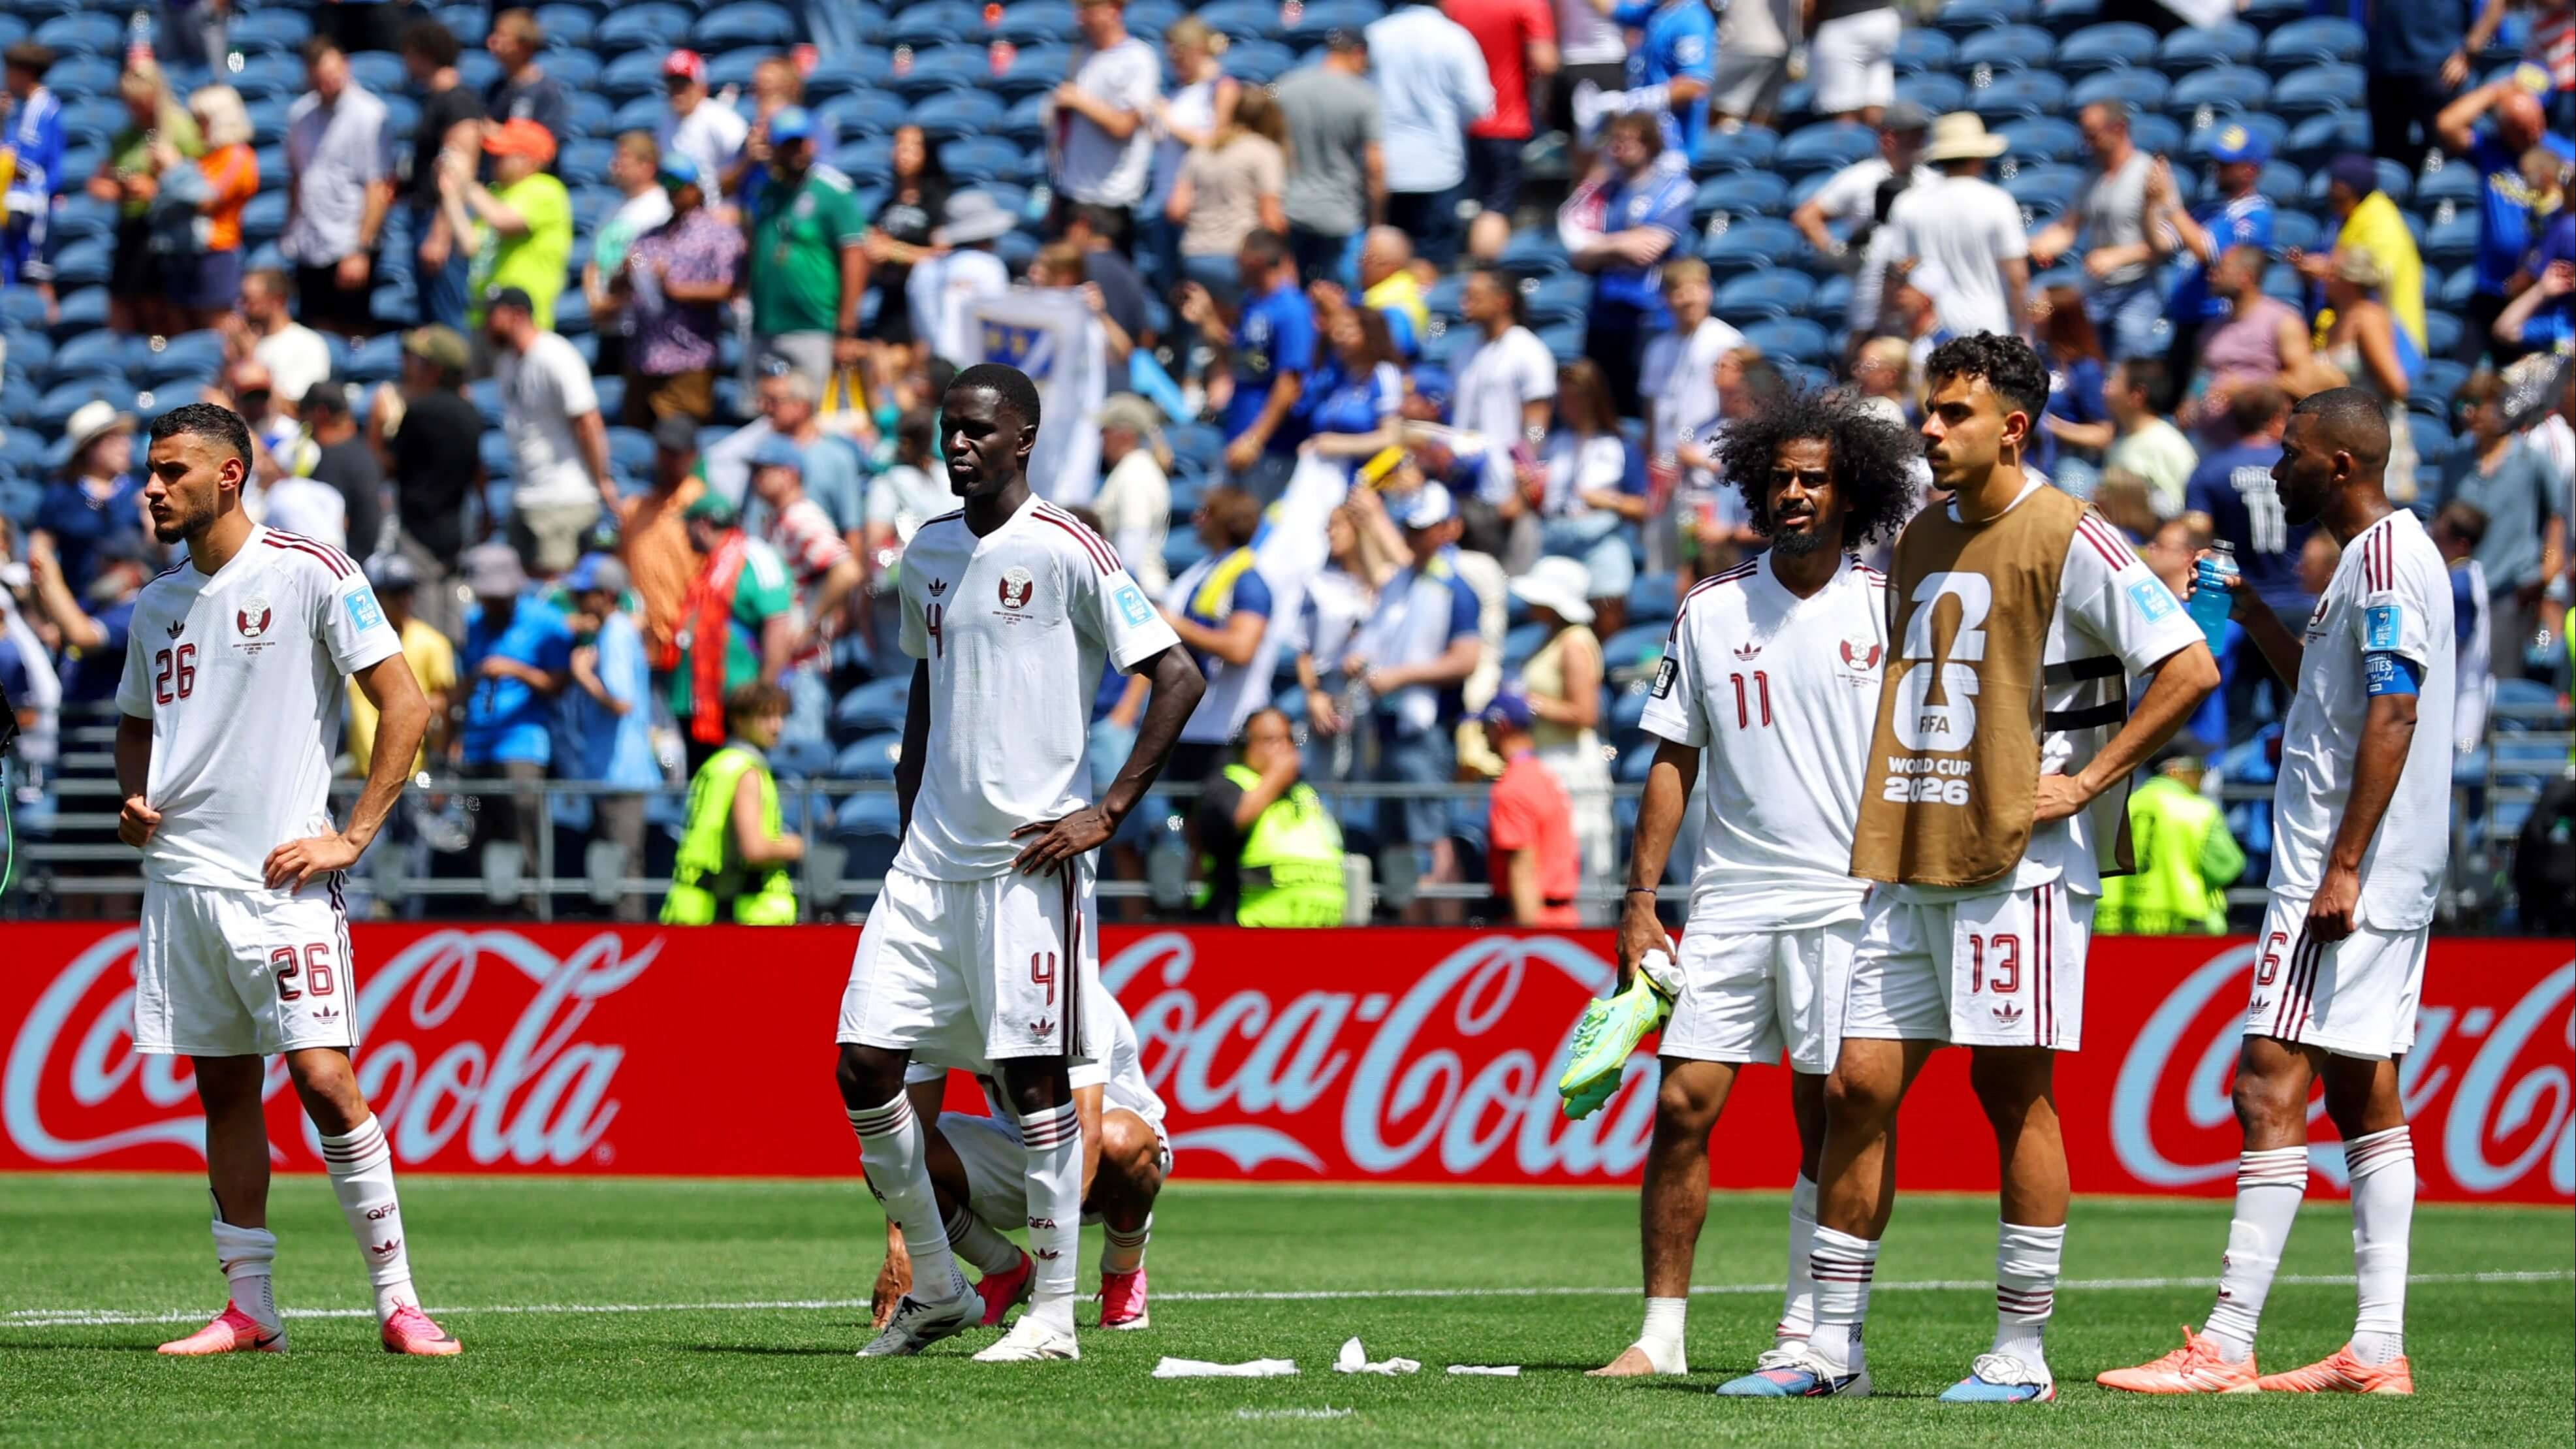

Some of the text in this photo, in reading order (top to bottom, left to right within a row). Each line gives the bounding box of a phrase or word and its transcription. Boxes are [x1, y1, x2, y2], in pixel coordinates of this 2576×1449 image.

[927, 603, 942, 660] 4
[155, 643, 196, 706] 26
[1730, 670, 1772, 731] 11
[1919, 715, 1950, 734] FIFA
[1883, 776, 1969, 805] 2026
[1888, 756, 1971, 776] WORLD CUP
[271, 942, 335, 1002] 26
[1031, 951, 1056, 1008] 4
[1969, 934, 2021, 996] 13
[2257, 932, 2288, 987] 6
[367, 1202, 396, 1220] QFA
[1028, 1216, 1057, 1229] QFA
